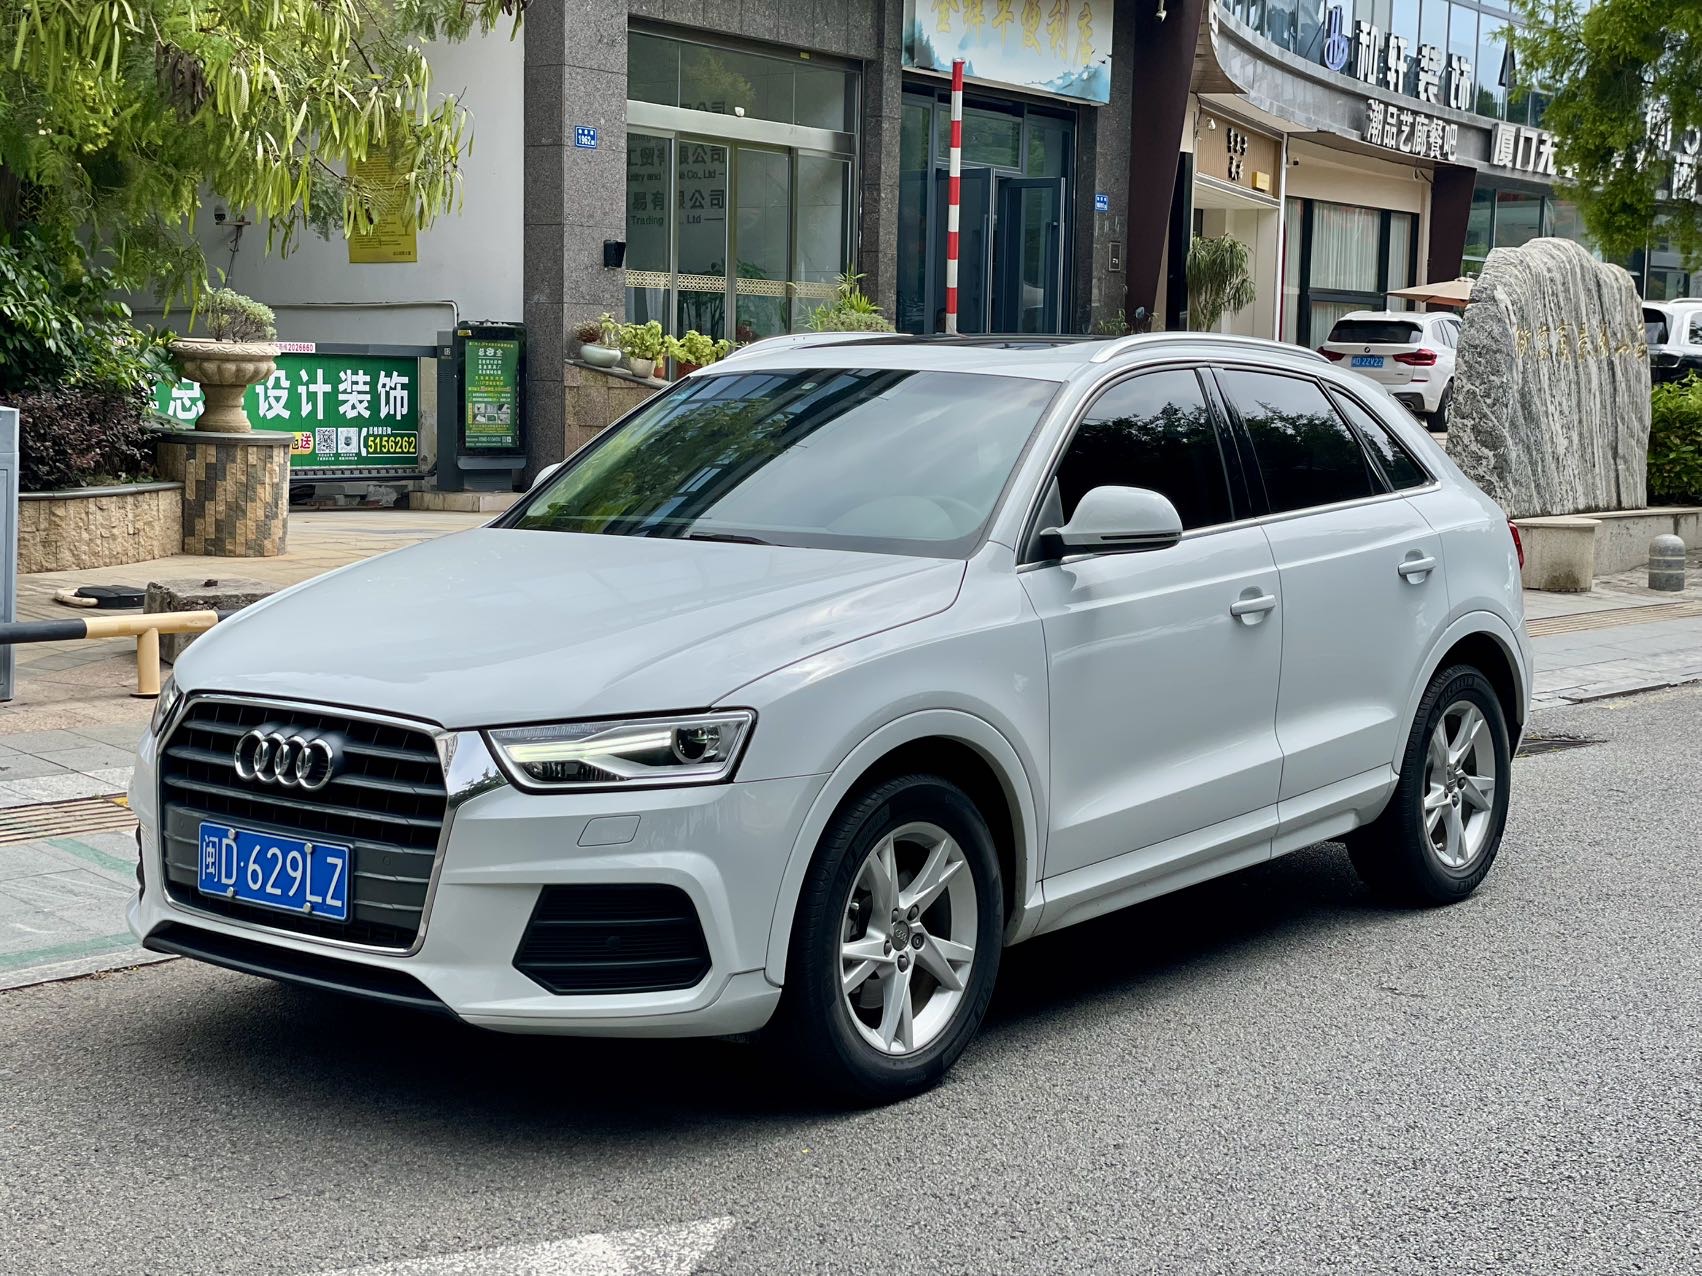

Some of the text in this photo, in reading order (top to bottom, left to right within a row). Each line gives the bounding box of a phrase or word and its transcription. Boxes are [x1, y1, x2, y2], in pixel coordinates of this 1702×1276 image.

[1355, 20, 1471, 111] 和轩装饰
[1367, 99, 1458, 161] 潮品艺廊餐吧
[367, 436, 416, 453] 5156262
[202, 835, 343, 908] 闽D·629LZ
